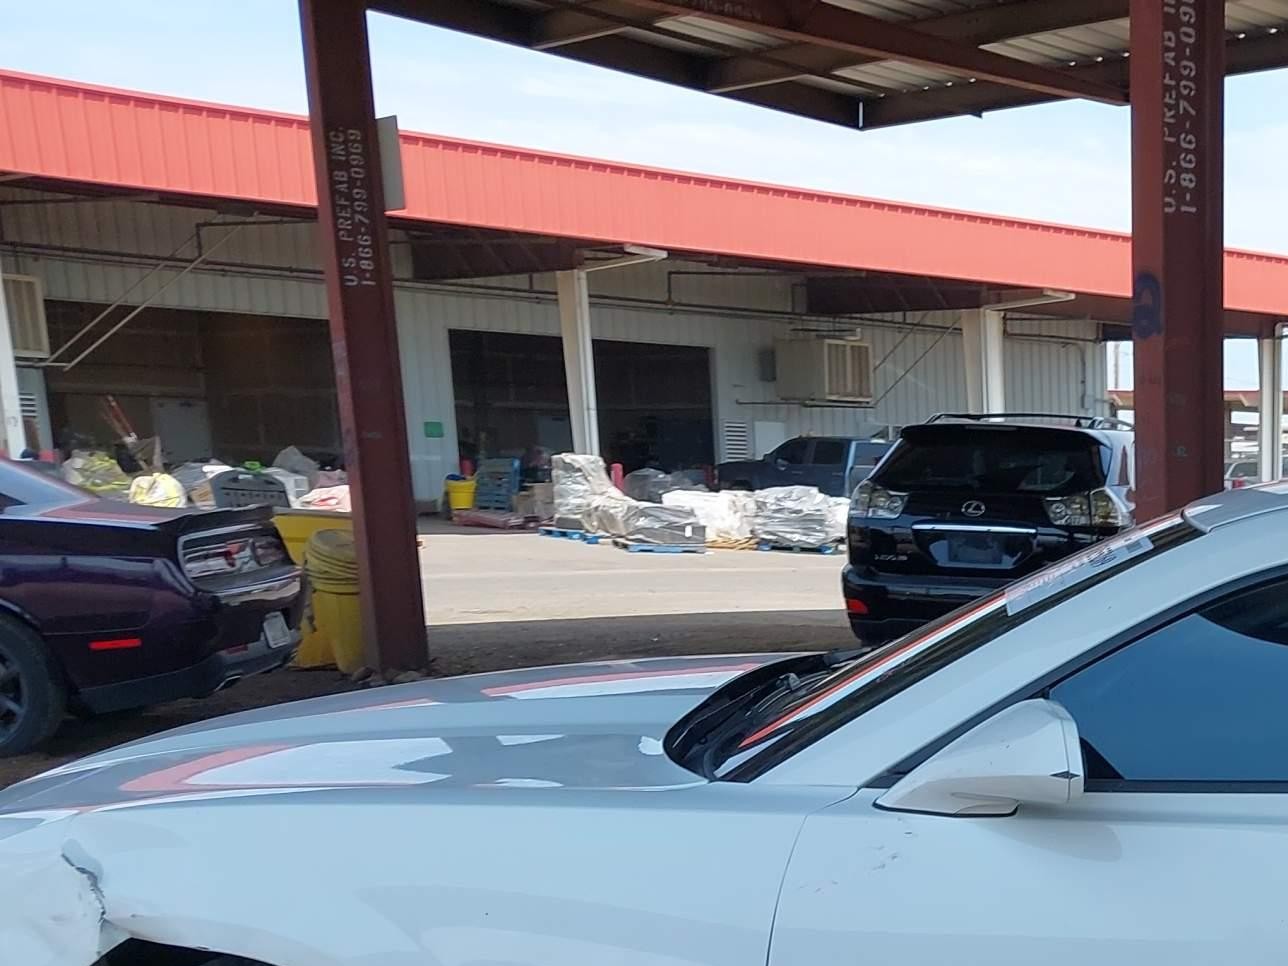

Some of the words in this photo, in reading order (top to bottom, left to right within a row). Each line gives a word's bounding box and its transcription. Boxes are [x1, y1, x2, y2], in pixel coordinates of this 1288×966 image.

[1179, 0, 1197, 213] 1-866-799-09
[329, 127, 346, 161] INC.
[333, 170, 353, 241] PREFAB
[347, 129, 376, 286] 1-866-799-0969
[342, 252, 360, 286] U.S.
